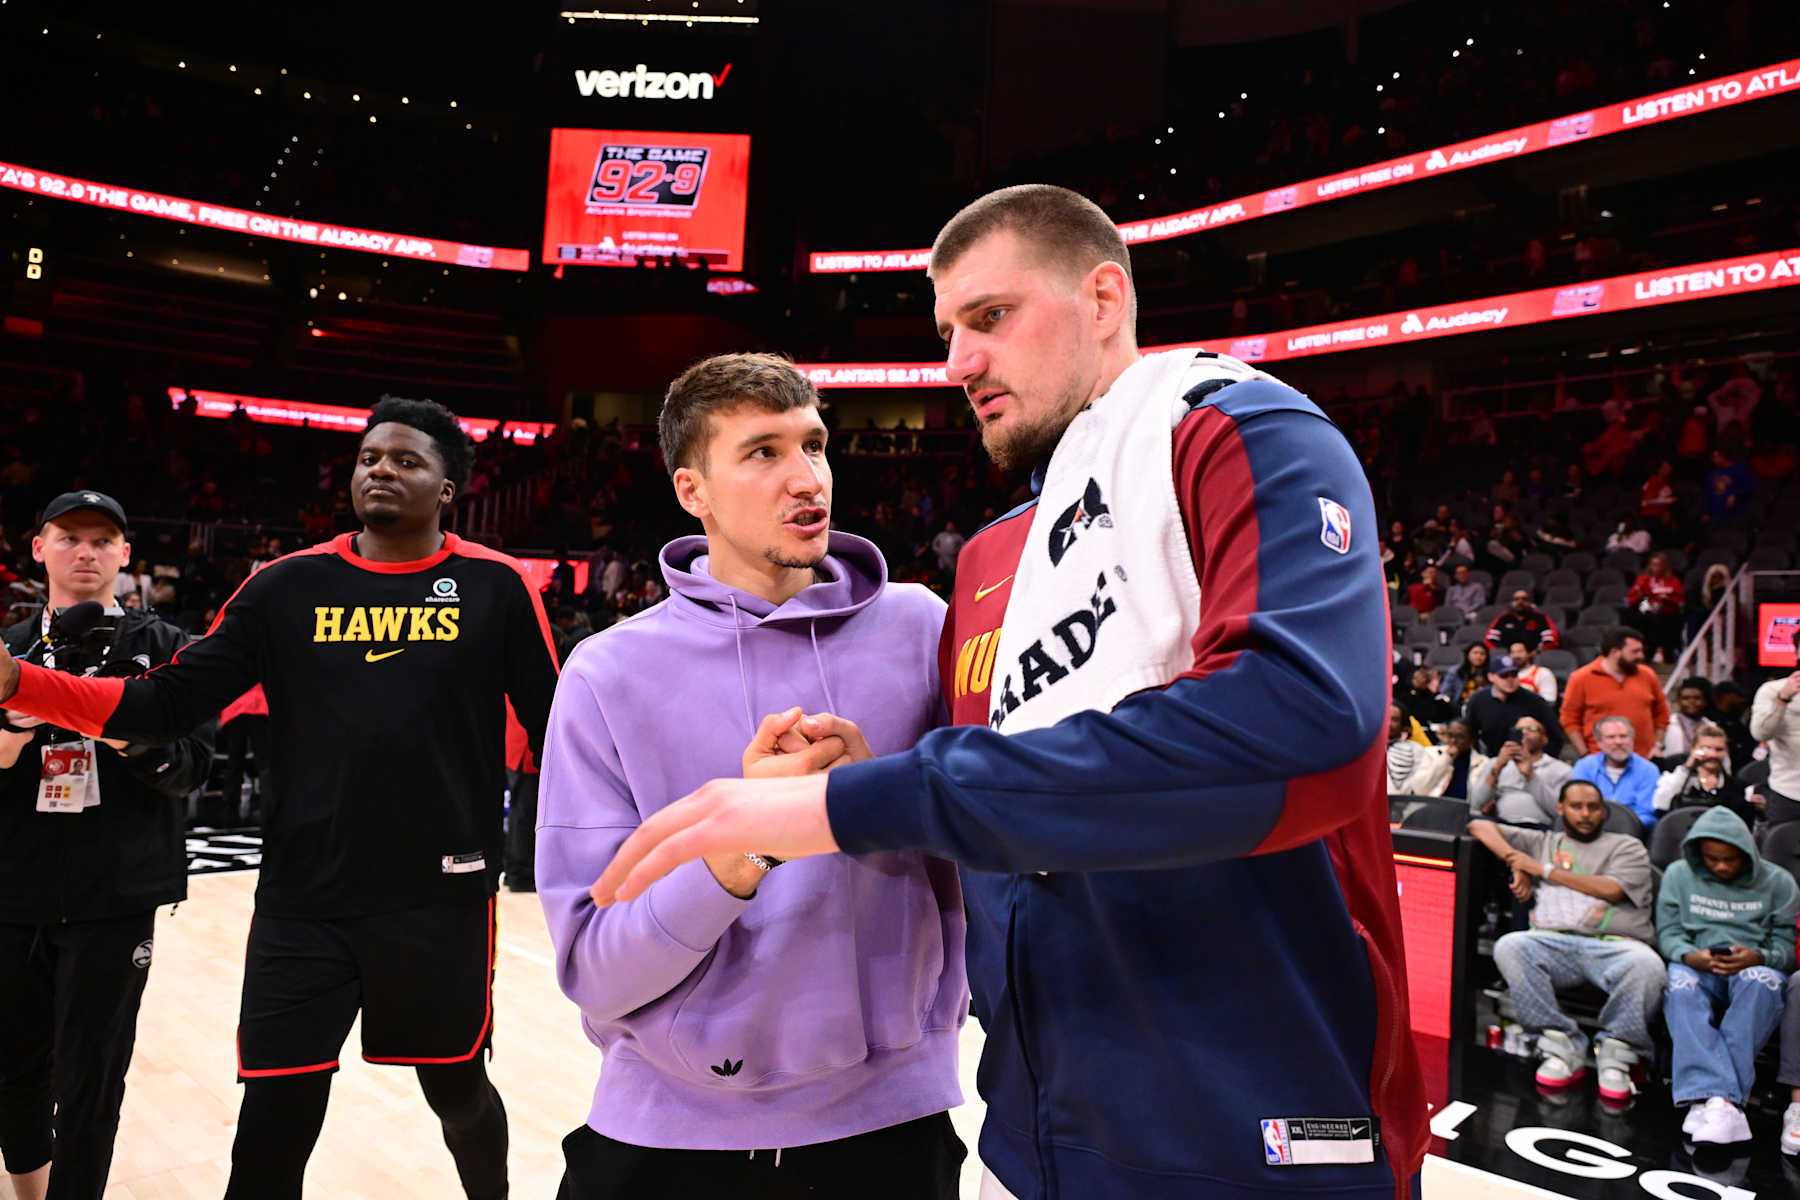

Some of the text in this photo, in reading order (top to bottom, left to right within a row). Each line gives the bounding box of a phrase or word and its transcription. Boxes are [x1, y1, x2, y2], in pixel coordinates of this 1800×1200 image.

[575, 64, 714, 99] verizon
[1623, 89, 1704, 124] LISTEN
[1707, 81, 1742, 103] TO
[606, 147, 705, 162] THE GAME
[1449, 137, 1527, 166] Audacy
[1317, 163, 1414, 197] LISTEN FREE ON
[39, 176, 85, 198] 92.9
[87, 185, 128, 207] THE
[130, 195, 195, 221] GAME,
[199, 207, 248, 229] FREE
[249, 216, 279, 235] ON
[281, 221, 318, 241] THE
[320, 228, 394, 251] AUDACY
[394, 238, 436, 258] APP.
[1119, 203, 1246, 242] THE AUDACY APP.
[815, 256, 863, 269] LISTEN
[864, 254, 883, 268] TO
[1635, 268, 1724, 300] LISTEN
[1726, 263, 1766, 285] TO
[1425, 307, 1508, 331] Audacy
[1287, 330, 1331, 351] LISTEN
[1332, 327, 1365, 345] FREE
[1365, 324, 1388, 339] ON
[313, 606, 460, 642] HAWKS
